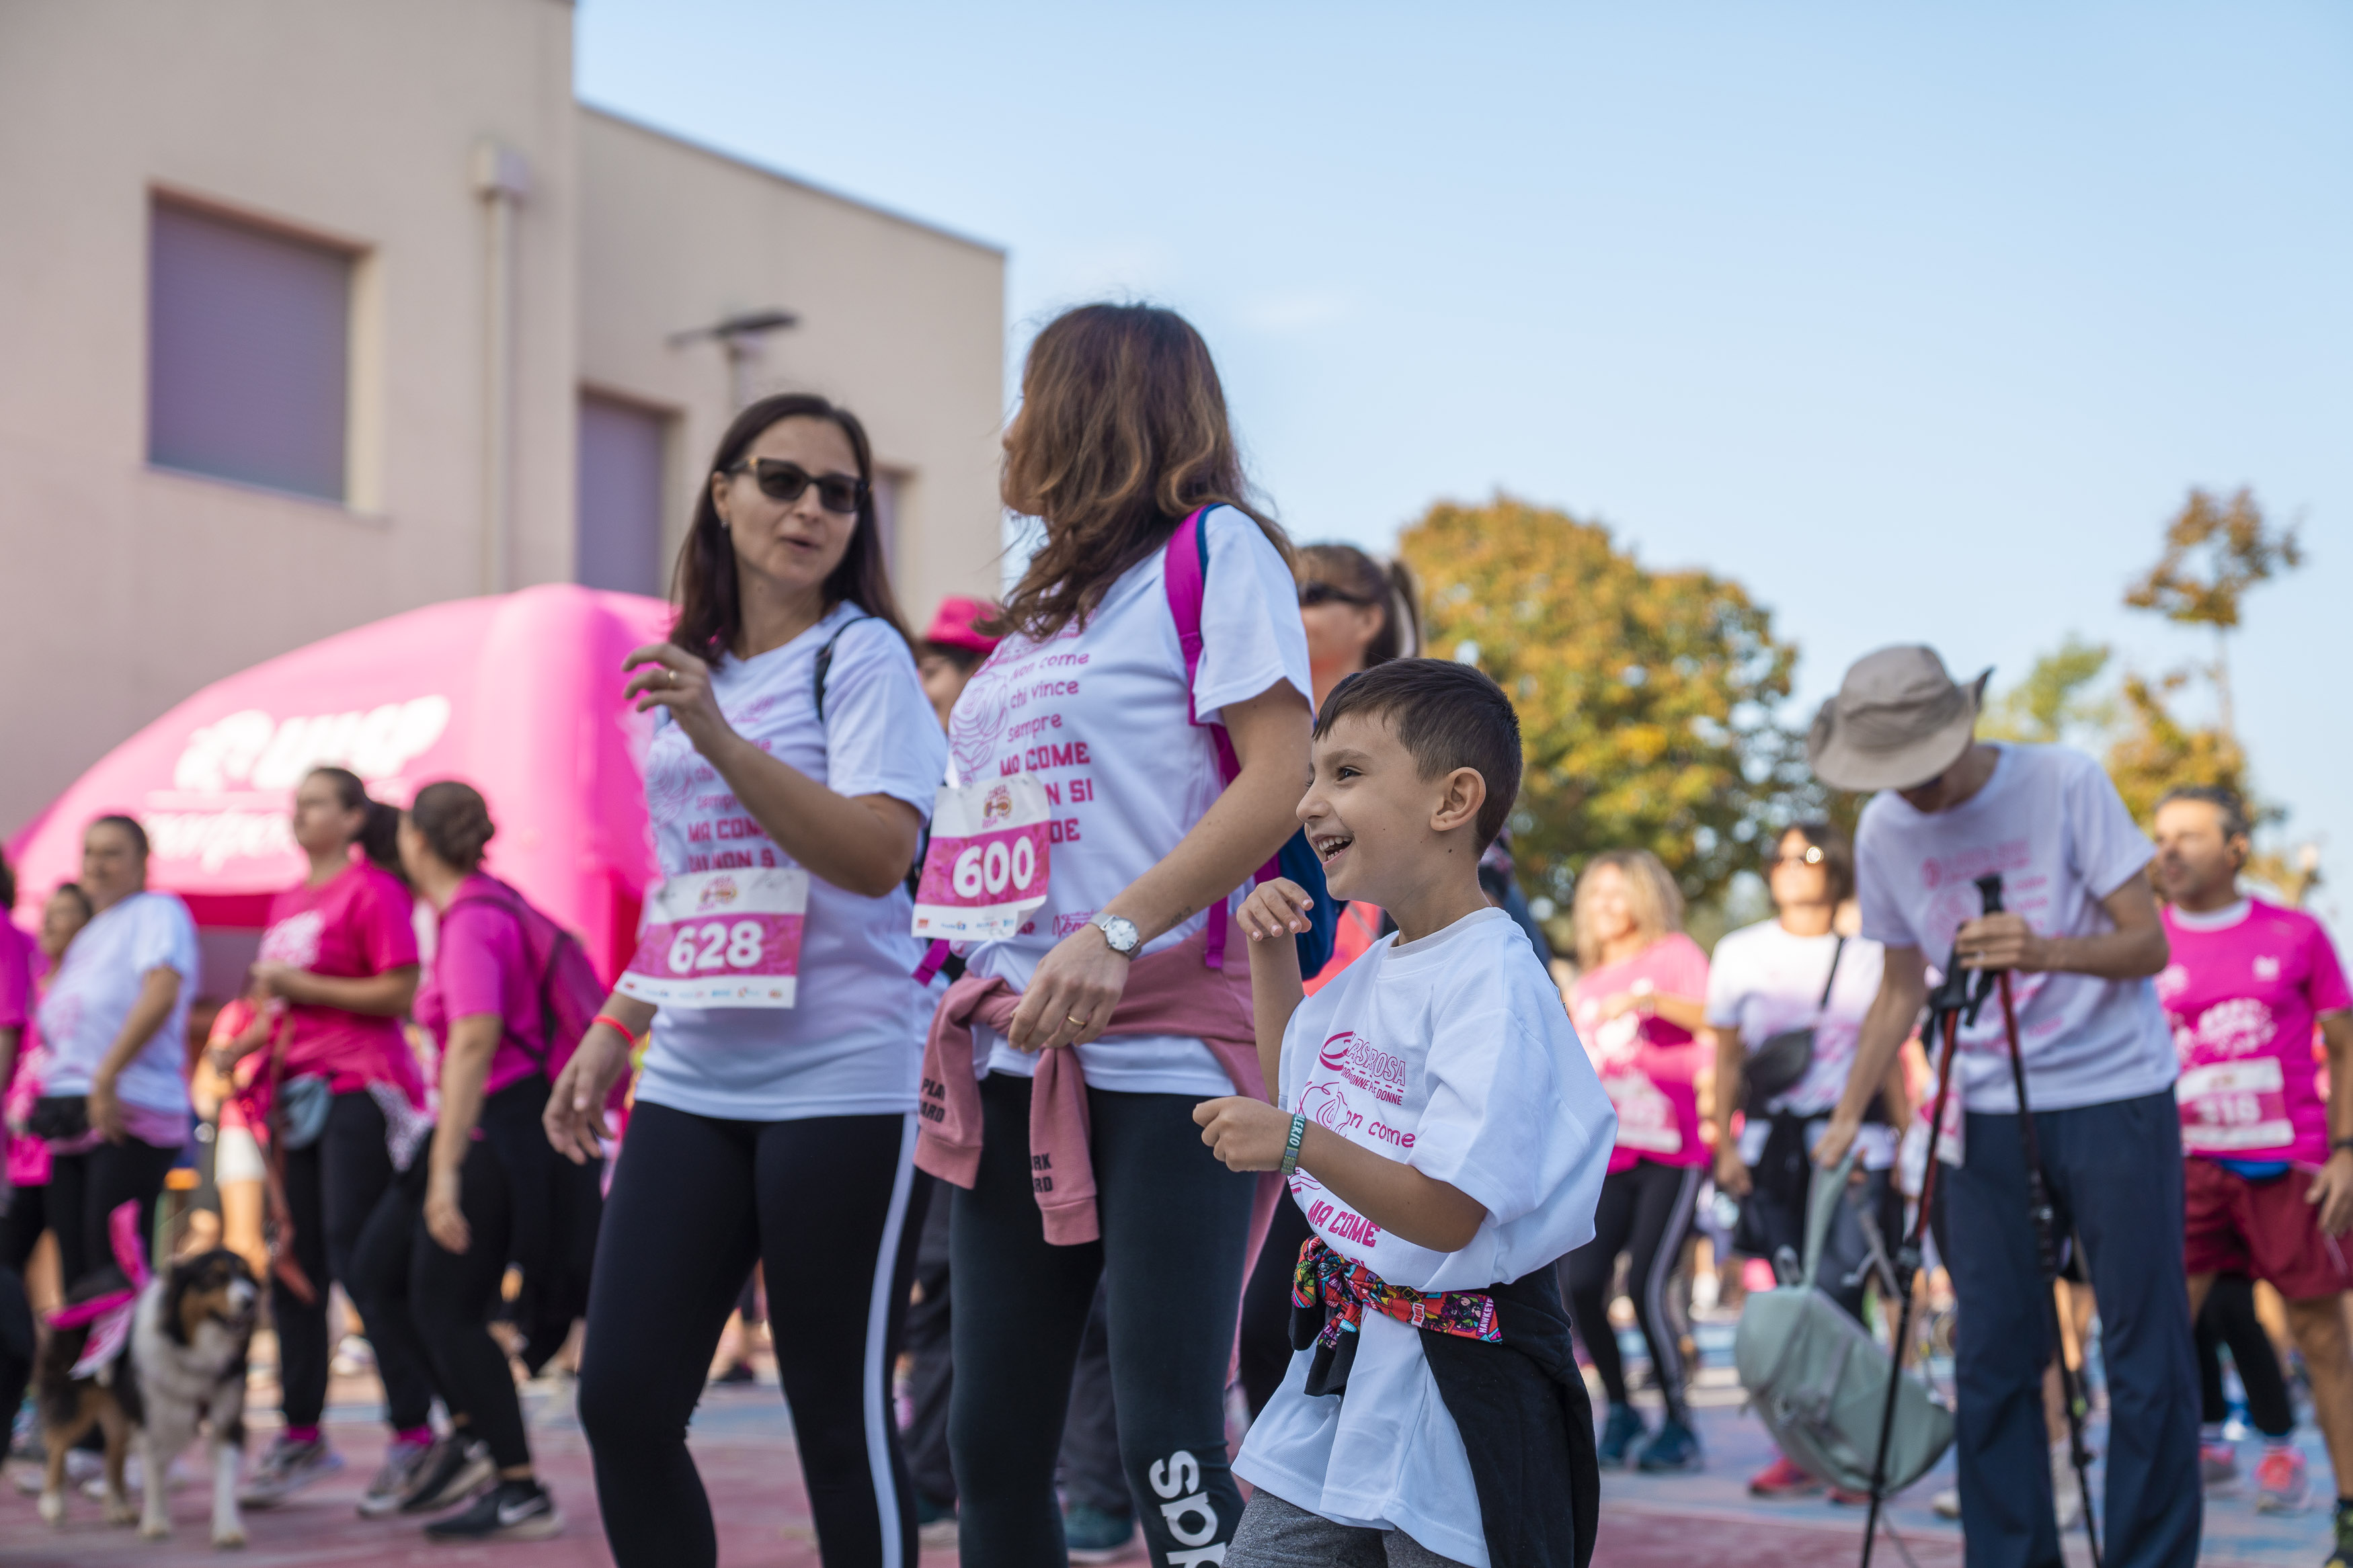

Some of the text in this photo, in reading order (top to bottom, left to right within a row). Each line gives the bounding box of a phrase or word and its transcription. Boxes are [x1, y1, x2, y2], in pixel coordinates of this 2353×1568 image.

[1039, 653, 1090, 669] come
[1010, 679, 1080, 710] chi vince
[1006, 713, 1063, 743] sempre
[1025, 741, 1091, 772] COME
[1069, 778, 1094, 803] SI
[716, 815, 773, 841] COM
[952, 835, 1035, 899] 600
[668, 919, 764, 975] 628
[920, 1077, 946, 1101] PLA
[1375, 1088, 1402, 1106] DONNE
[920, 1101, 945, 1124] ARD
[1368, 1121, 1416, 1148] come
[1307, 1198, 1382, 1248] MA COME
